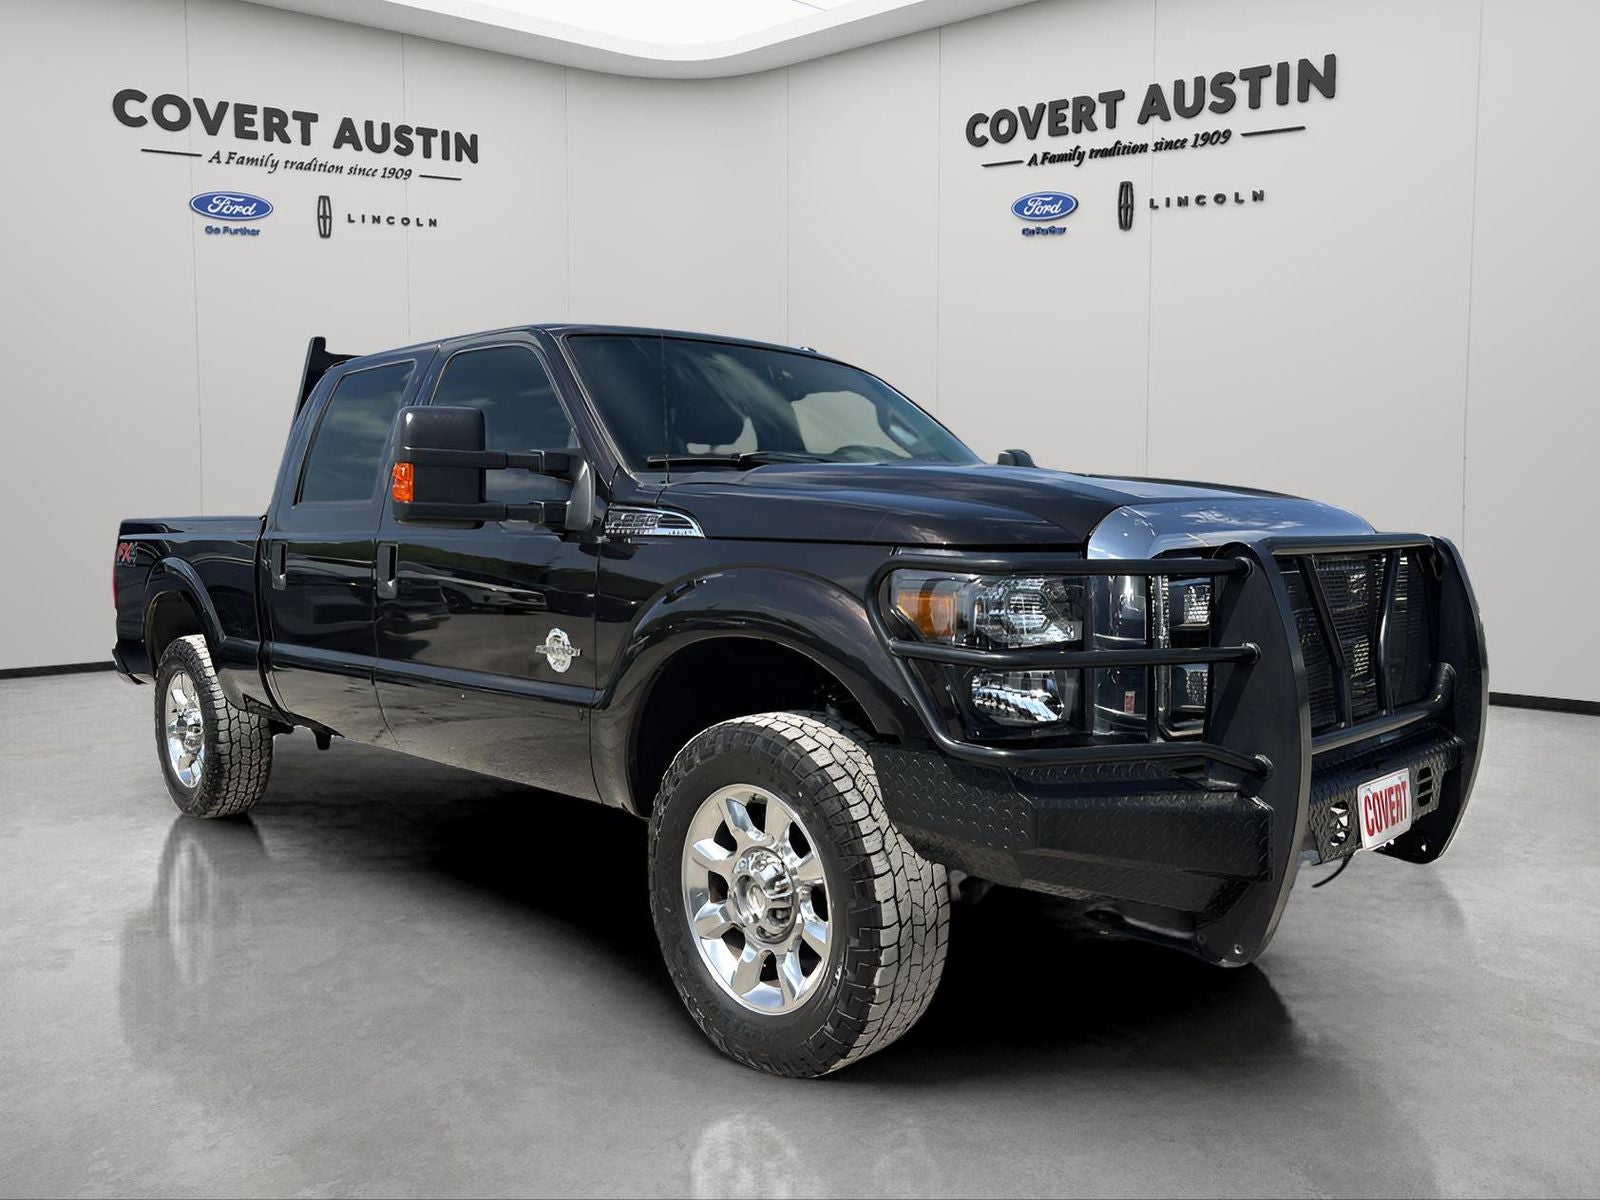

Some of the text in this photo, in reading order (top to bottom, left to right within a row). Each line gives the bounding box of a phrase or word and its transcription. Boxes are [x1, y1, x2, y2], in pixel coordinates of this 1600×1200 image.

[966, 54, 1337, 147] COVERT AUSTIN
[112, 88, 479, 164] COVERT AUSTIN
[1027, 129, 1232, 167] A Family tradition since 1909
[208, 151, 412, 180] A Family tradition since 1909
[208, 195, 257, 215] Ford
[1024, 197, 1062, 215] Ford
[1149, 189, 1265, 210] LINCOLN
[223, 226, 260, 236] Further
[348, 213, 438, 228] LINCOLN
[1364, 780, 1408, 837] COVERT
